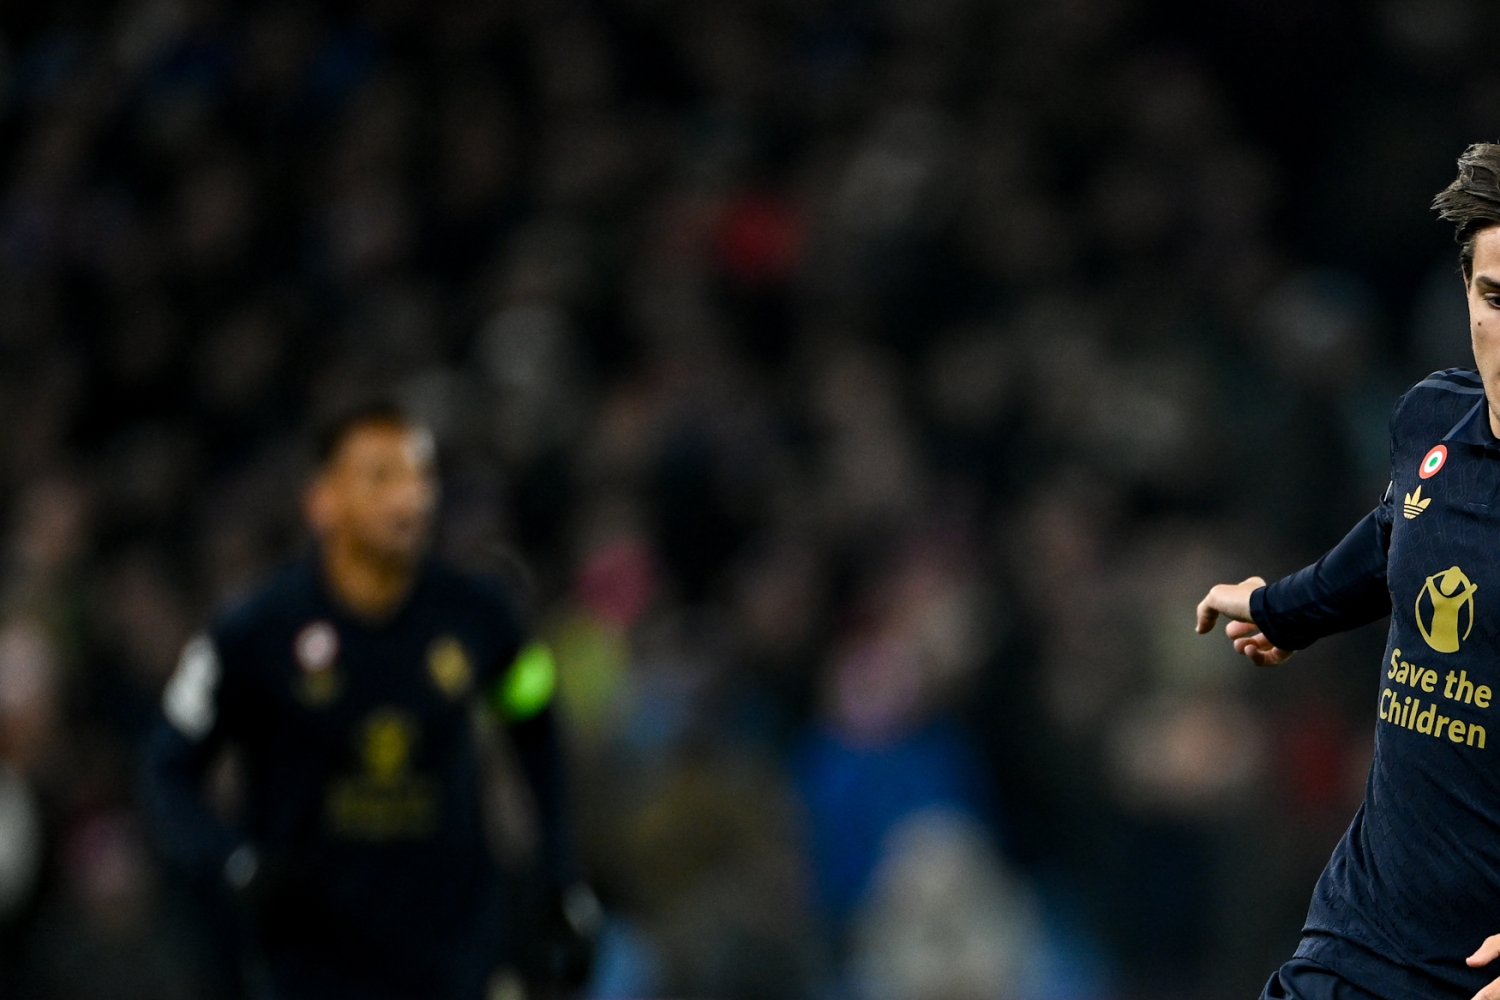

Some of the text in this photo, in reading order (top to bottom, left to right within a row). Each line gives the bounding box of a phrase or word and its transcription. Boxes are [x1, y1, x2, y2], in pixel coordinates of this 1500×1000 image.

[1387, 648, 1493, 708] Save the
[1379, 688, 1487, 749] Children
